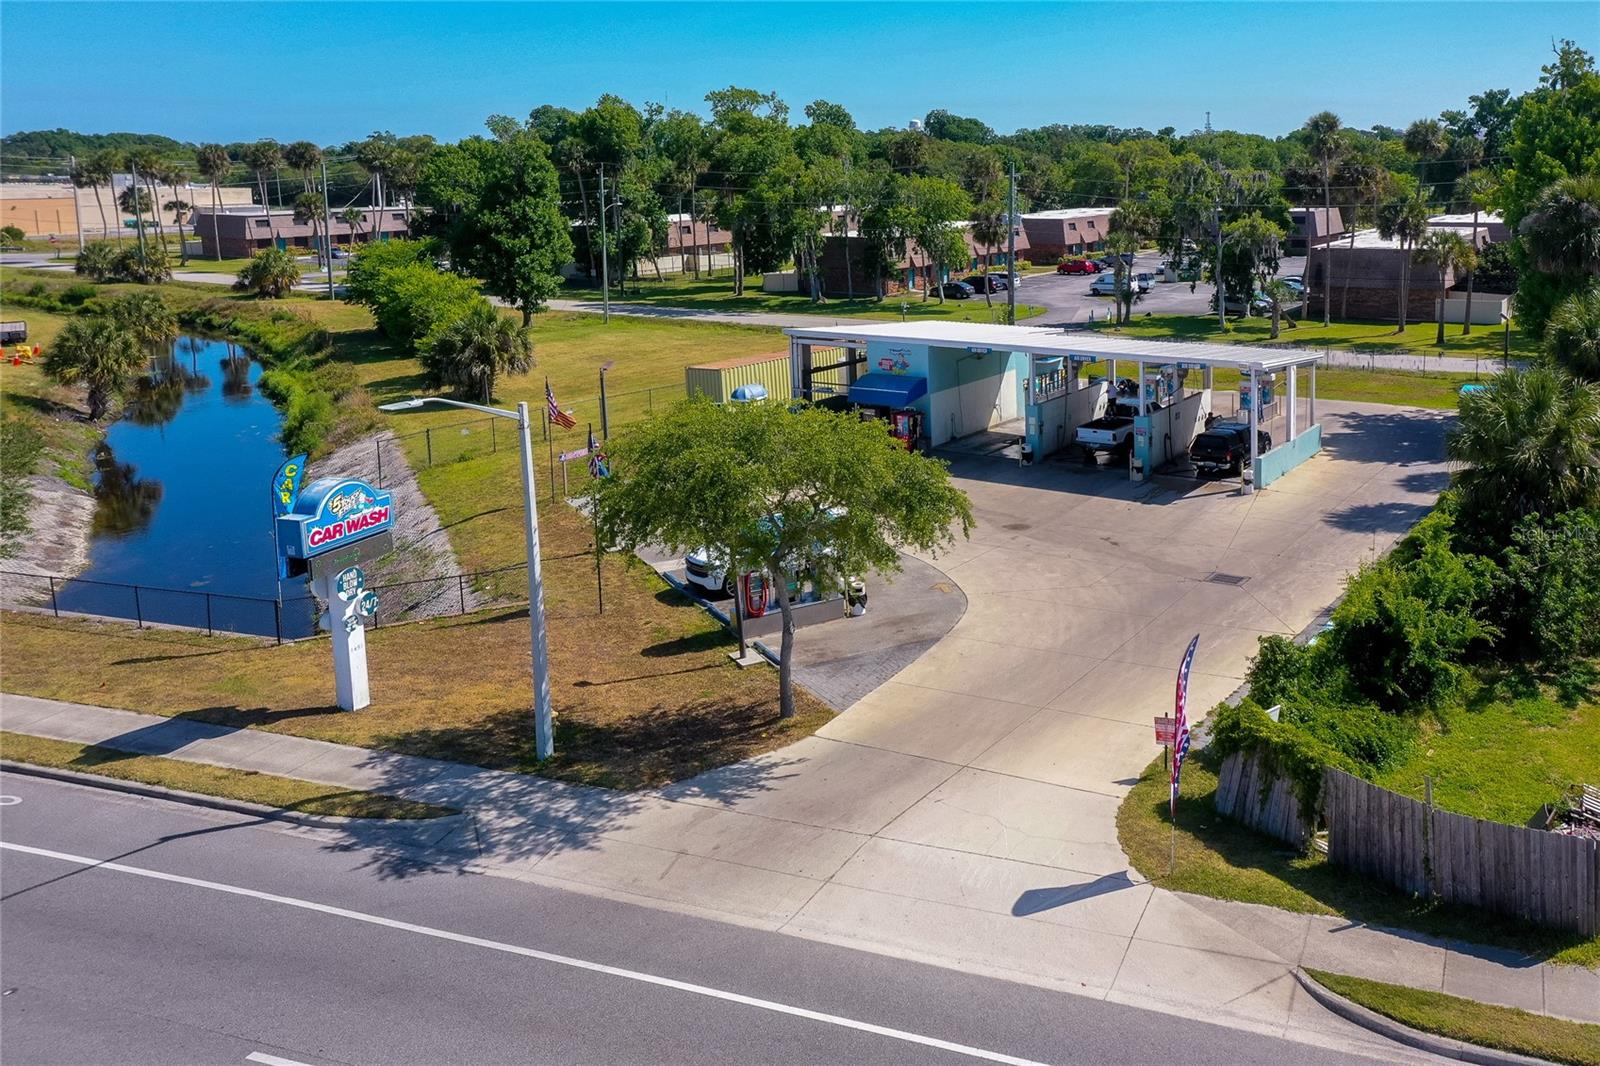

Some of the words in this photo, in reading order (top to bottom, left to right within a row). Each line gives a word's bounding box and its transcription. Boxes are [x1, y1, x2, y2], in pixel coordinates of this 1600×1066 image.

[280, 464, 298, 504] CAR
[310, 523, 344, 546] CAR
[345, 507, 388, 533] WASH
[342, 570, 357, 582] HAND
[343, 578, 358, 590] BLOW
[361, 596, 379, 610] 24/7
